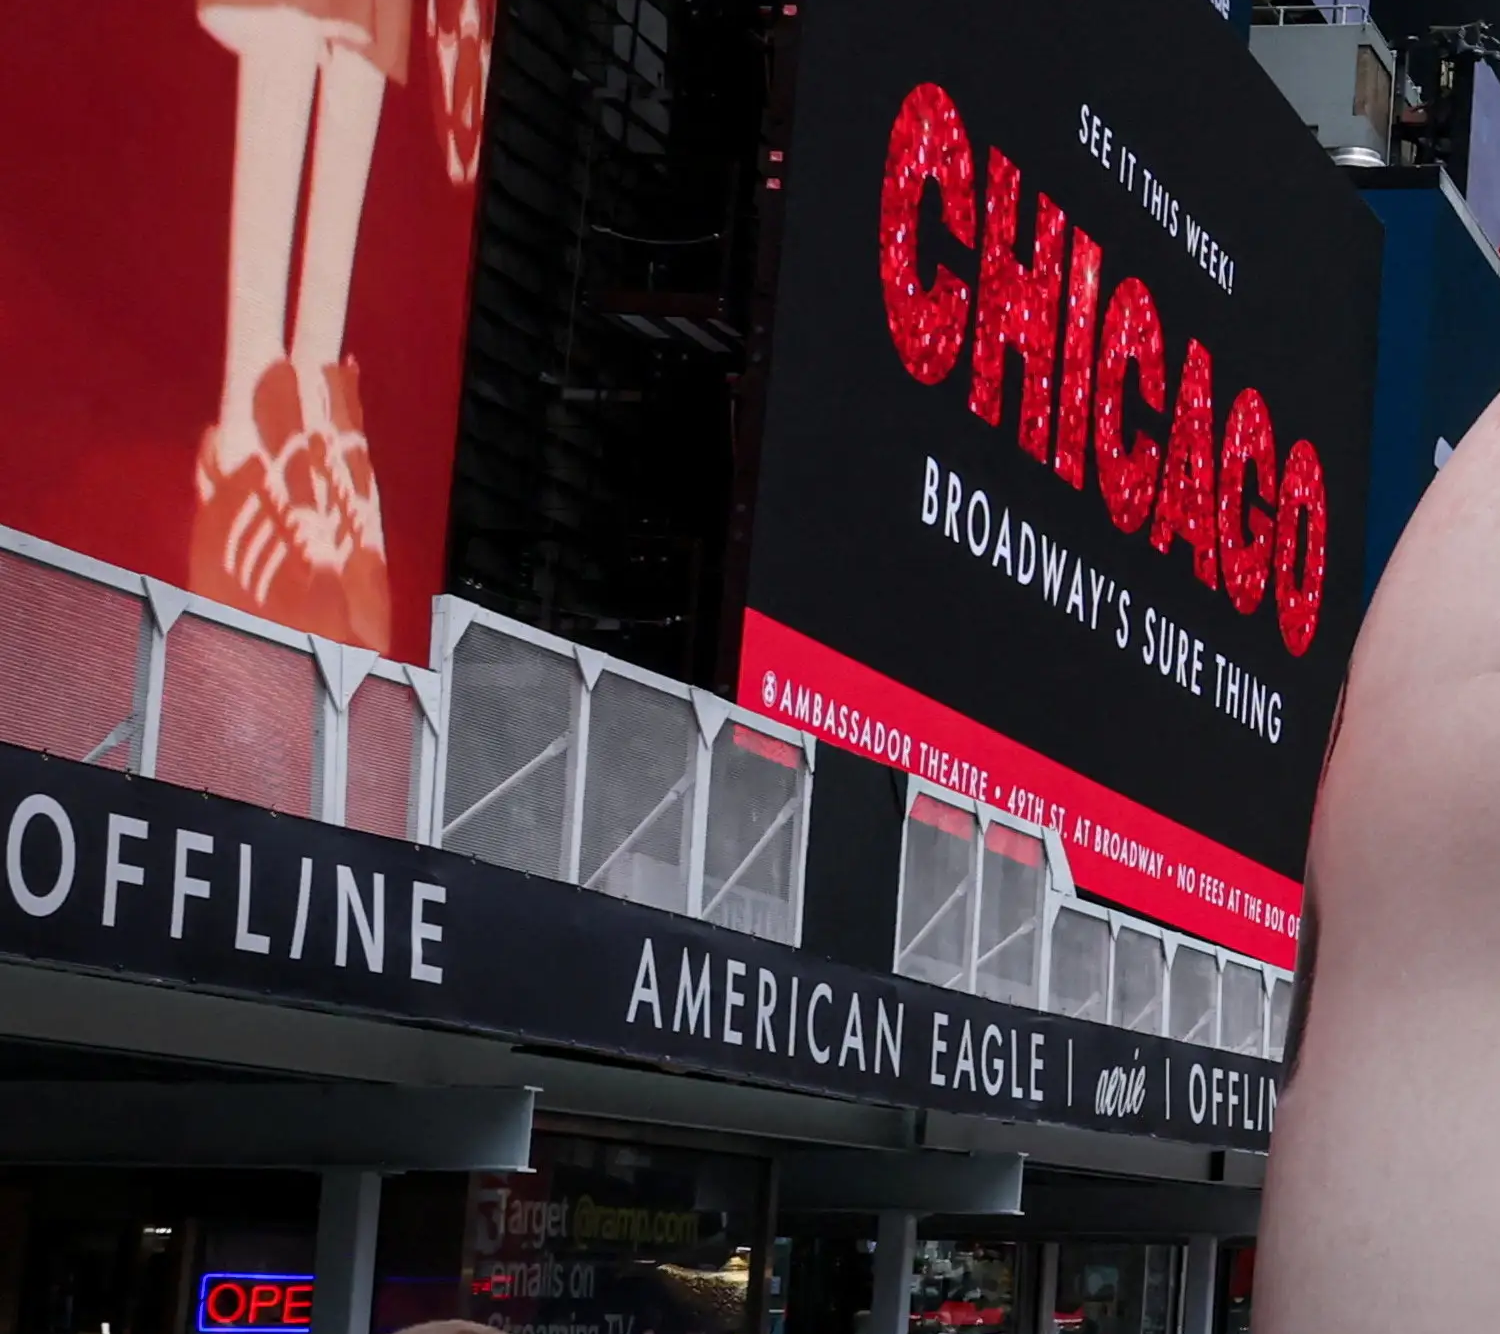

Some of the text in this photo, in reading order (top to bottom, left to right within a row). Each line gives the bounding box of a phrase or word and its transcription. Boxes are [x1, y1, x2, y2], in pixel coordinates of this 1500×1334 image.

[1078, 103, 1236, 295] SEE IT THIS WEEK!
[878, 81, 1328, 657] CHICAGO
[922, 455, 1284, 744] BROADWAY'S SURE THING
[6, 793, 448, 985] OFFLINE
[779, 679, 912, 768] AMBASSADOR
[918, 740, 988, 804] THEATRE
[1006, 784, 1045, 827] 49TH
[1049, 804, 1068, 841] ST.
[1073, 814, 1093, 846] AT
[1094, 824, 1164, 881] BROADWAY
[1176, 862, 1196, 894] NO
[1199, 872, 1225, 908] FEES
[1226, 885, 1242, 914] AT
[1242, 890, 1262, 925] THE
[1264, 901, 1286, 935] BOX
[626, 938, 904, 1077] AMERICAN
[930, 1012, 1044, 1103] EAGLE
[1094, 1046, 1148, 1120] aerie
[490, 1261, 594, 1301] emails on
[496, 1189, 569, 1245] Target
